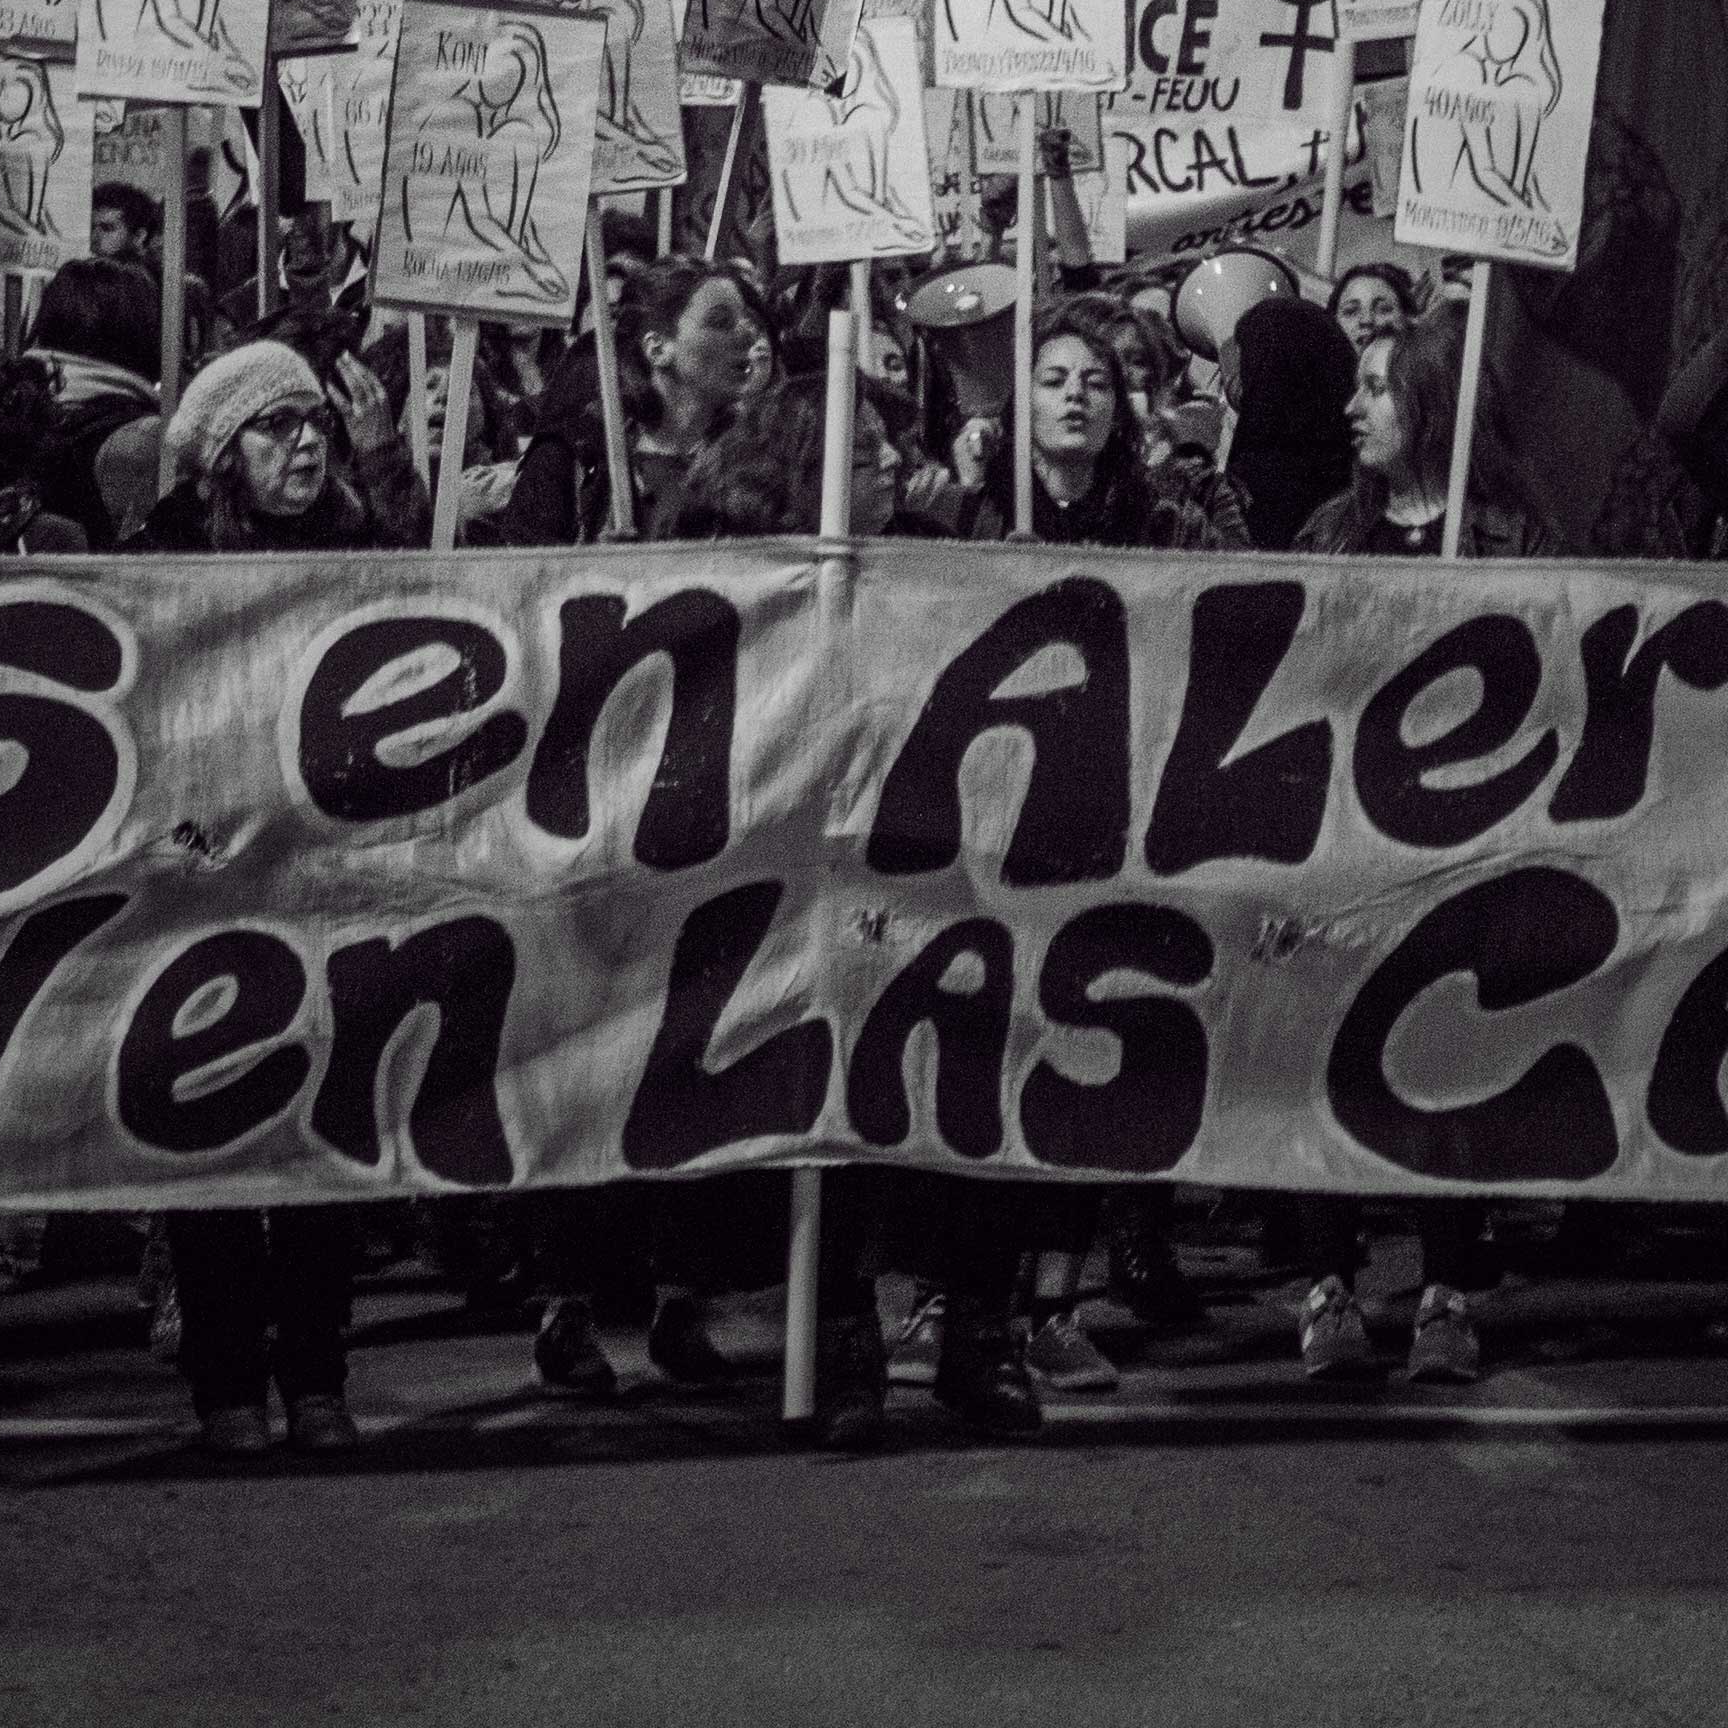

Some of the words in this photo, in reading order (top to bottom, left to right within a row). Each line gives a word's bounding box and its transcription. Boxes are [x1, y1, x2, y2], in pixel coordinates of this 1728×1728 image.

[298, 586, 742, 870] en
[116, 913, 519, 1187] en
[622, 878, 1214, 1174] LAS
